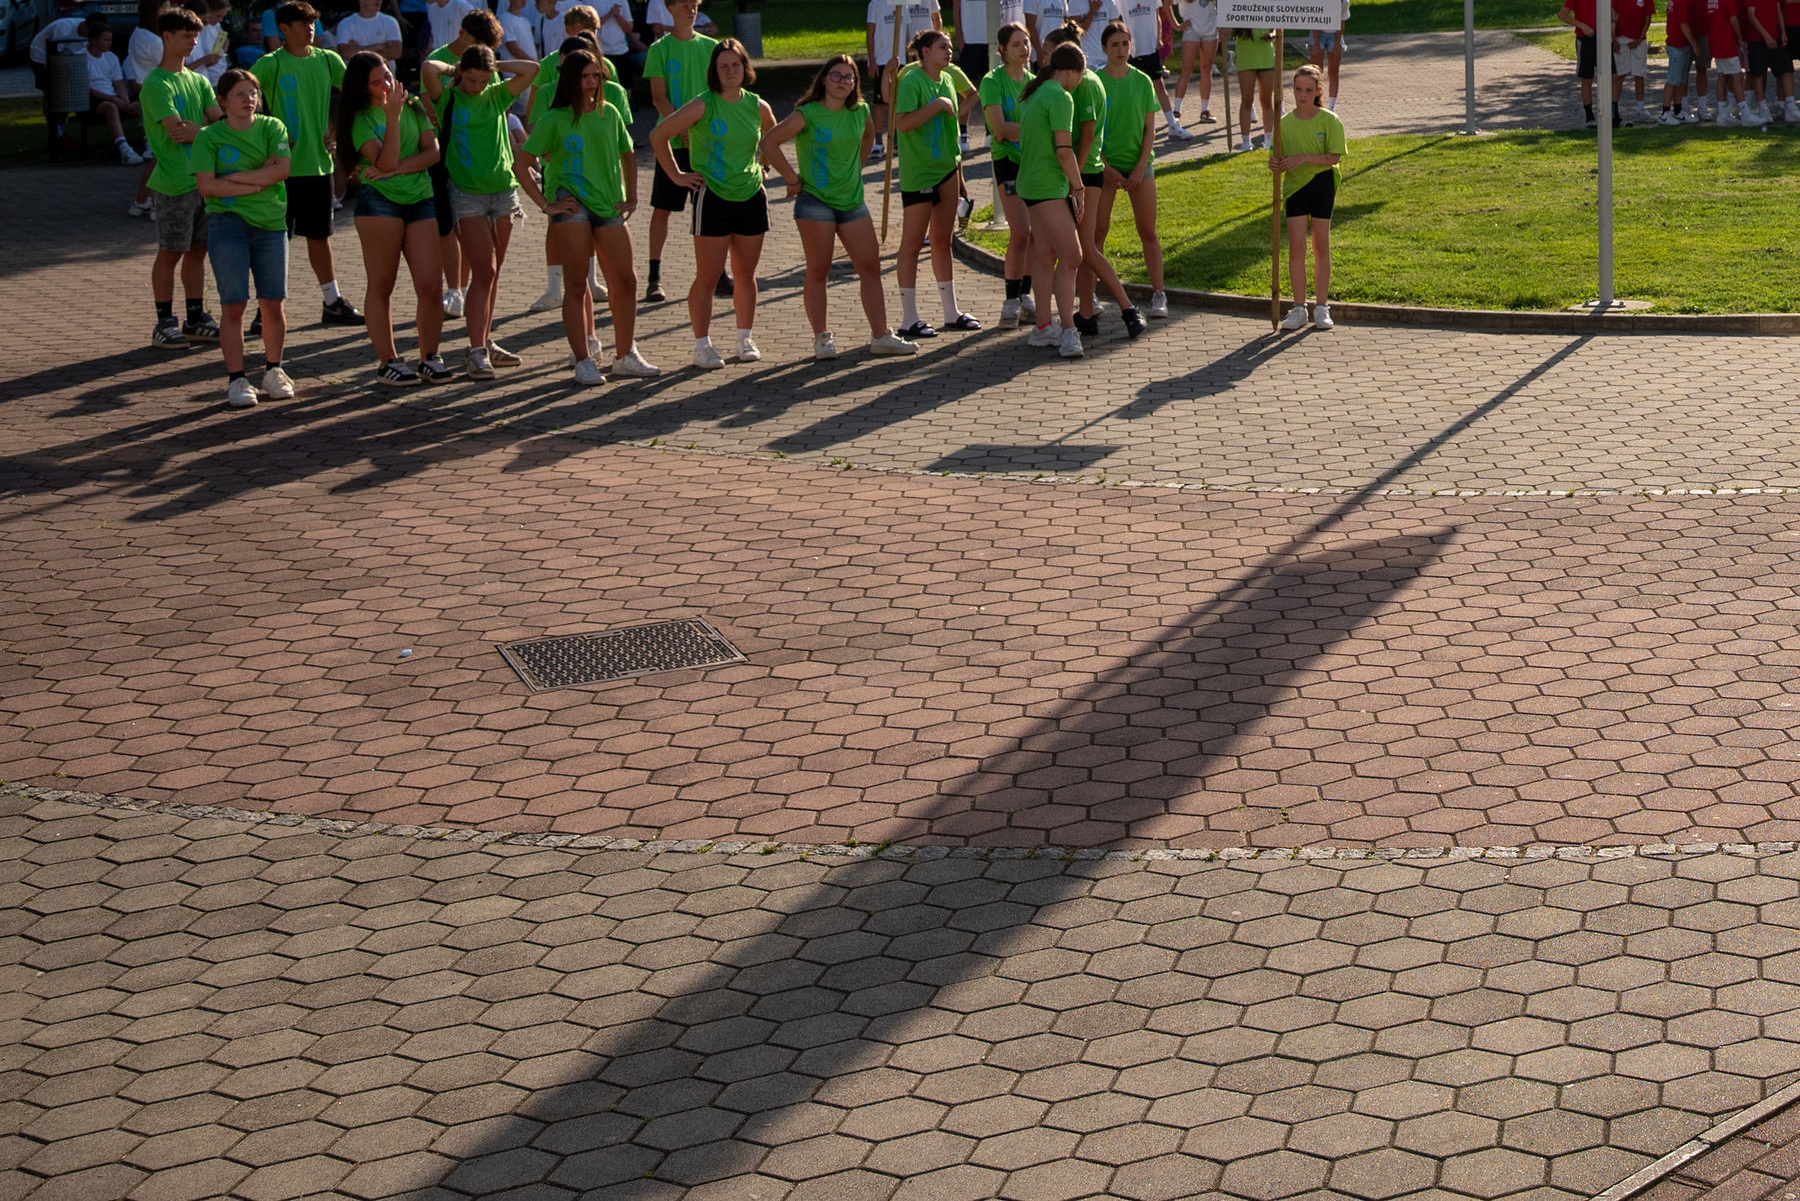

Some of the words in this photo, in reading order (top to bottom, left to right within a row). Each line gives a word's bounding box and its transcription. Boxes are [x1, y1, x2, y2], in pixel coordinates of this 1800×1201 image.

[1232, 4, 1275, 13] ZDRUŽENJE
[1276, 5, 1324, 14] SLOVENSKIH
[1226, 13, 1264, 22] ŠPORTNIH
[1265, 14, 1300, 23] DRUŠTEV
[1307, 16, 1332, 25] ITALIJI
